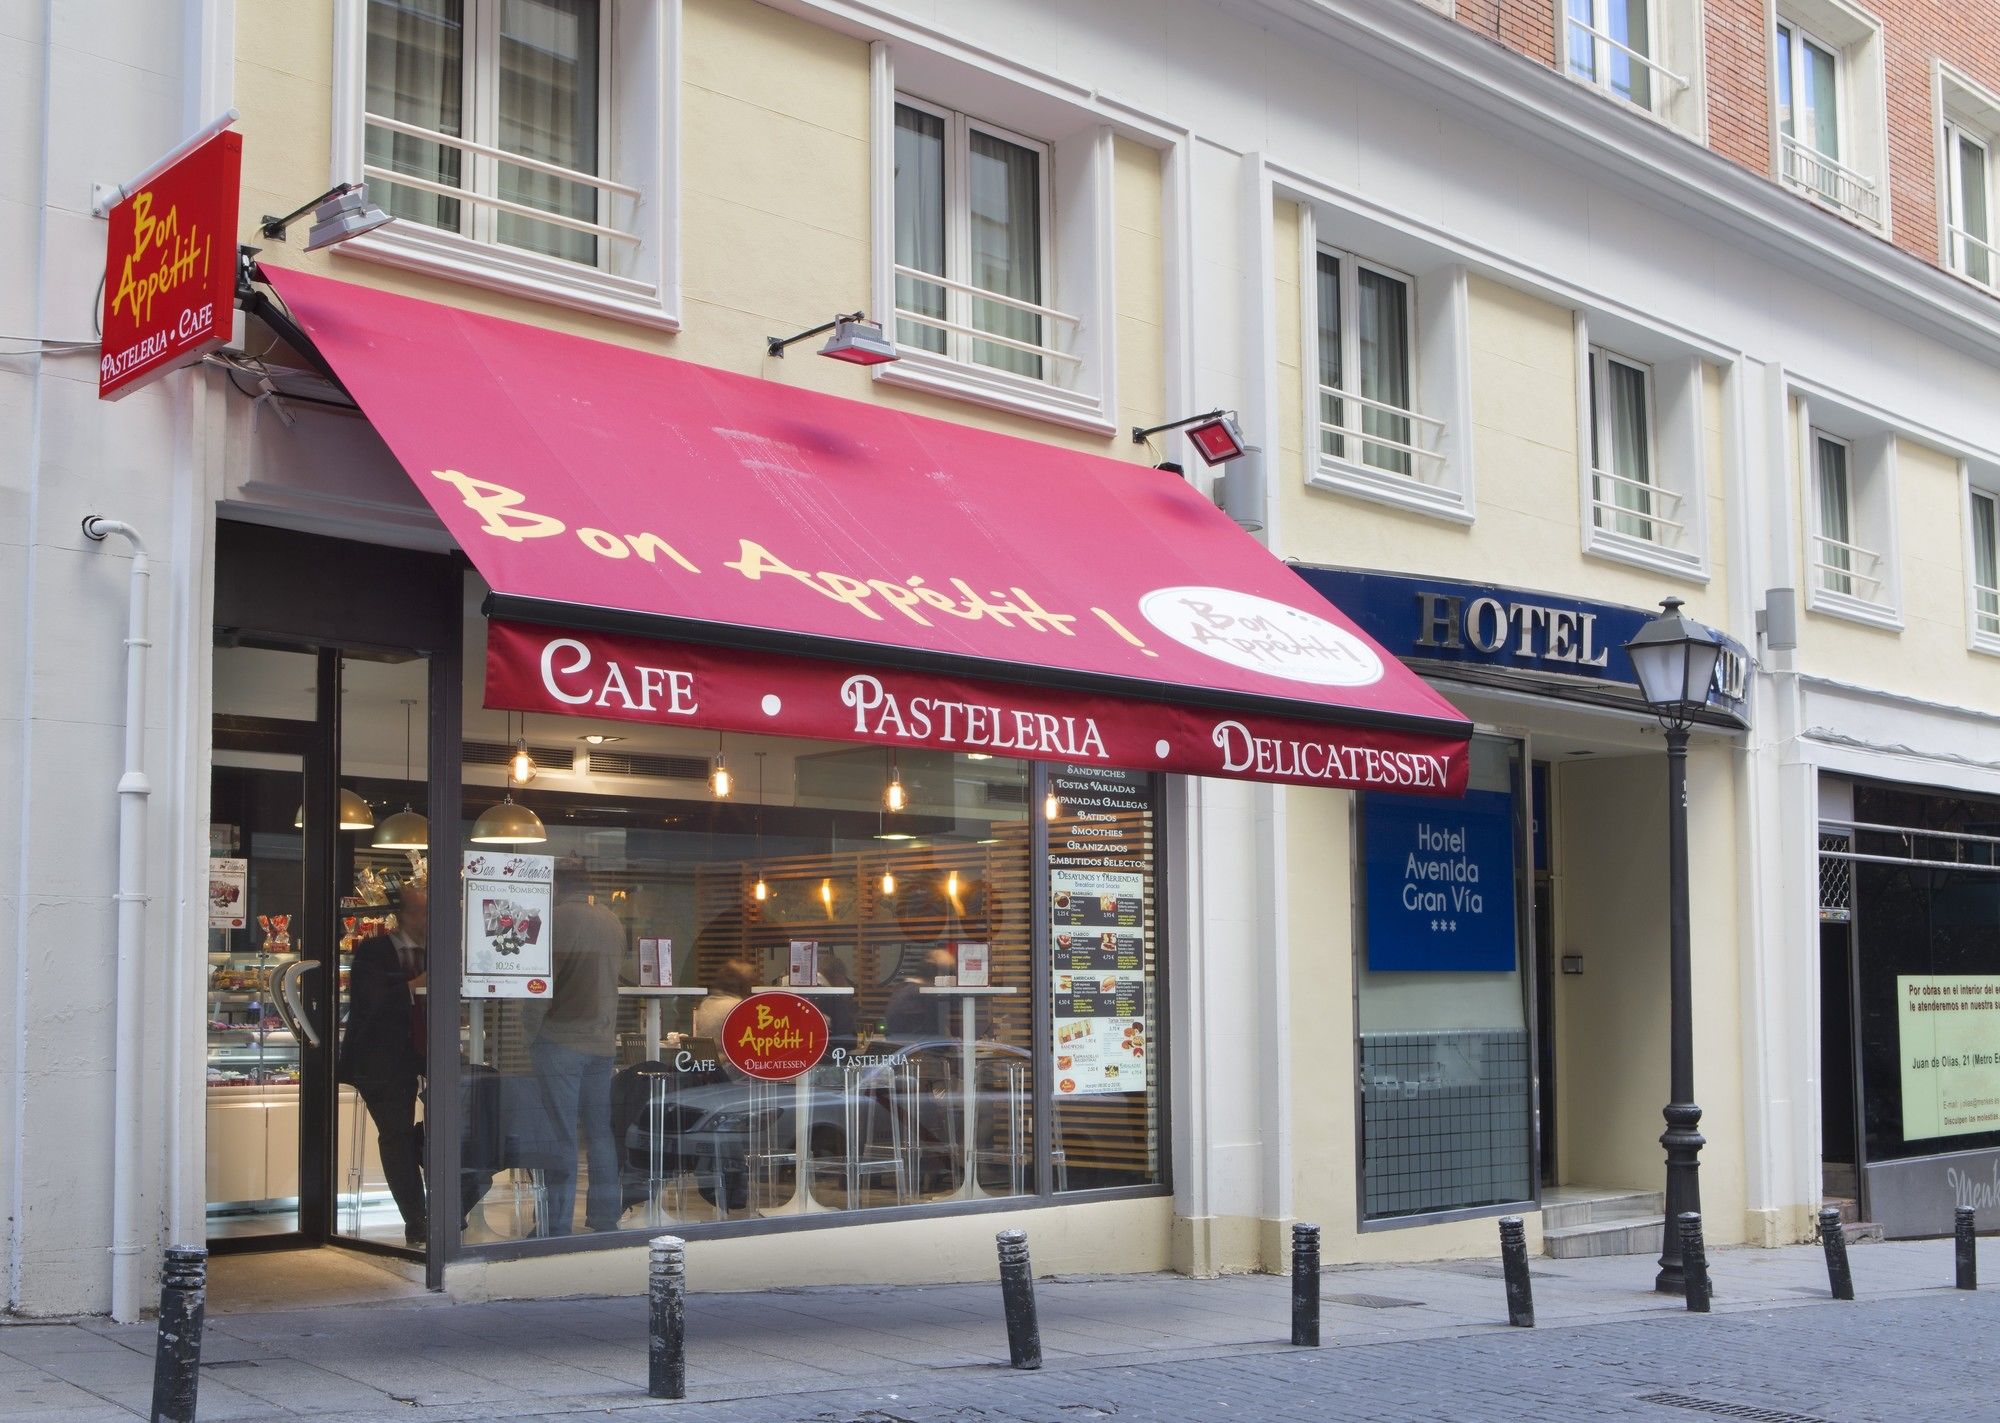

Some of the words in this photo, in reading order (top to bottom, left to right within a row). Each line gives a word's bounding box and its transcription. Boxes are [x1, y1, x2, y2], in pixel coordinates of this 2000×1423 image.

[133, 191, 177, 262] Bon
[101, 330, 167, 381] PASTELERIA
[179, 303, 212, 338] CAFE
[431, 470, 701, 573] Bon
[1178, 598, 1286, 634] Bon
[1415, 591, 1609, 668] HOTEL
[540, 638, 698, 715] CAFE
[840, 674, 1109, 758] PASTELERIA
[1212, 721, 1450, 788] DELICATESSEN
[1067, 765, 1126, 779] SANDWICHES
[1057, 779, 1089, 790] TOSTAS
[1090, 781, 1136, 794] VARIADAS
[1054, 795, 1101, 806] MPANADAS
[1103, 797, 1148, 810] GALLEGAS
[1077, 811, 1117, 822] BATIDOS
[1071, 826, 1123, 838] SMOOTHIES
[1418, 823, 1465, 853] Hotel
[1067, 841, 1128, 853] GRANIZADOS
[1048, 855, 1101, 866] EMBUTIDOS
[1103, 857, 1146, 868] SELECTOS
[1405, 852, 1479, 883] Avenida
[1402, 883, 1447, 911] Gran
[1451, 885, 1483, 913] Vía
[1909, 984, 1920, 995] Por
[1923, 984, 1941, 995] obras
[1943, 986, 1951, 995] en
[1952, 984, 1959, 995] el
[1960, 984, 1983, 994] interior
[1984, 984, 1993, 994] del
[756, 1004, 789, 1030] Bon
[1909, 1001, 1916, 1011] le
[1918, 1000, 1959, 1011] atenderemos
[1960, 1002, 1969, 1010] en
[1970, 1001, 1993, 1010] nuestra
[738, 1026, 803, 1056] Appétit
[675, 1051, 716, 1072] CAFE
[745, 1059, 806, 1070] DELICATESSEN
[832, 1048, 909, 1067] PASTELERIA
[1912, 1058, 1929, 1069] Juan
[1931, 1057, 1939, 1067] de
[1963, 1055, 1970, 1065] 21
[1972, 1054, 1993, 1067] (Metro
